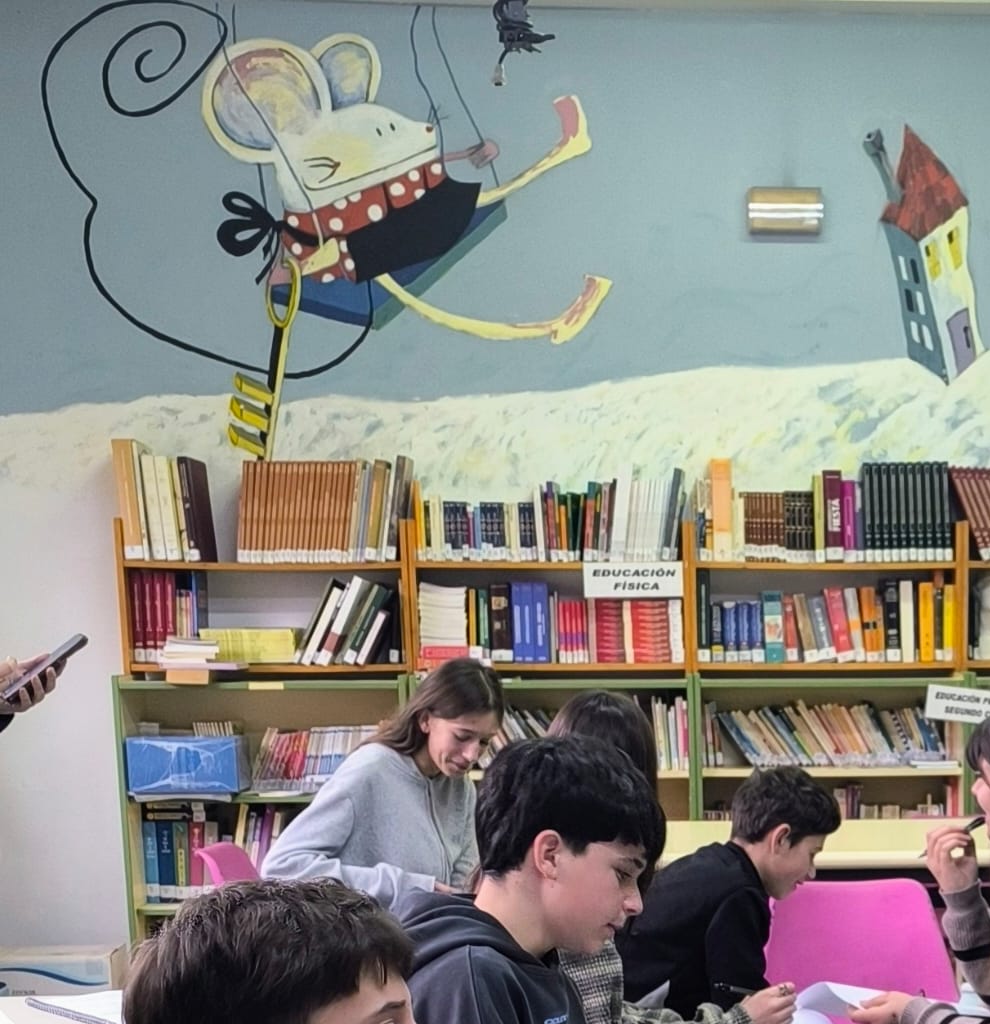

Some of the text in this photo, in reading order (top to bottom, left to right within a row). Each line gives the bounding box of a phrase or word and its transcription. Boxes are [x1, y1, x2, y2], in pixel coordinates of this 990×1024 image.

[826, 498, 842, 532] FIESTA
[592, 567, 676, 577] EDUCACIÓN
[613, 581, 660, 591] FÍSICA
[935, 691, 981, 704] EDUCACIÓN
[944, 705, 983, 717] SEGUNDO
